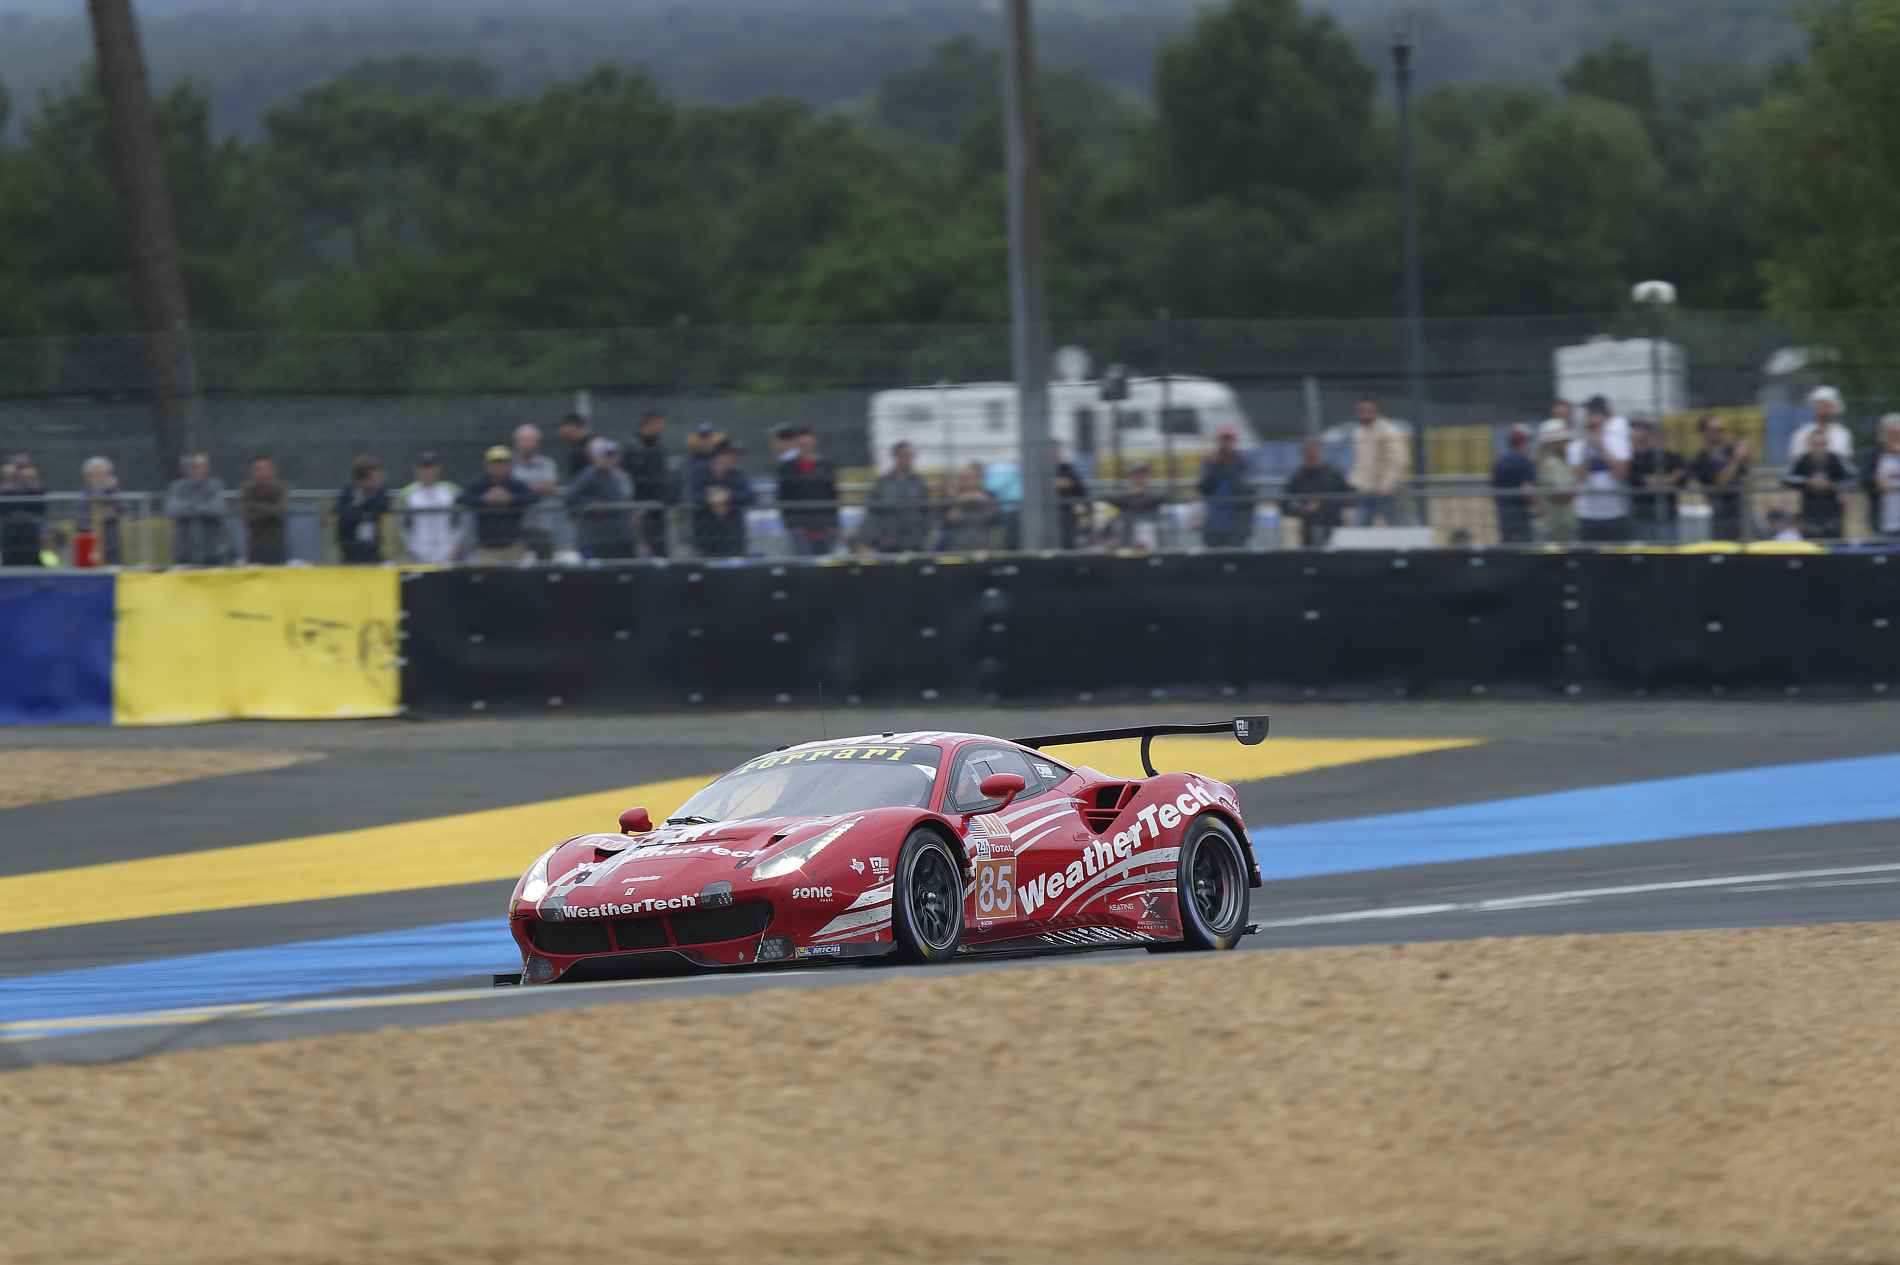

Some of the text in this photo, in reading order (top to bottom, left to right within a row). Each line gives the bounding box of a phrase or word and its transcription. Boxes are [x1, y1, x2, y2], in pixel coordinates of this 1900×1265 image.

[990, 844, 1014, 853] TOTAL
[1018, 782, 1212, 915] WeatherTech
[979, 865, 1012, 912] 85
[562, 895, 697, 919] WeatherTech
